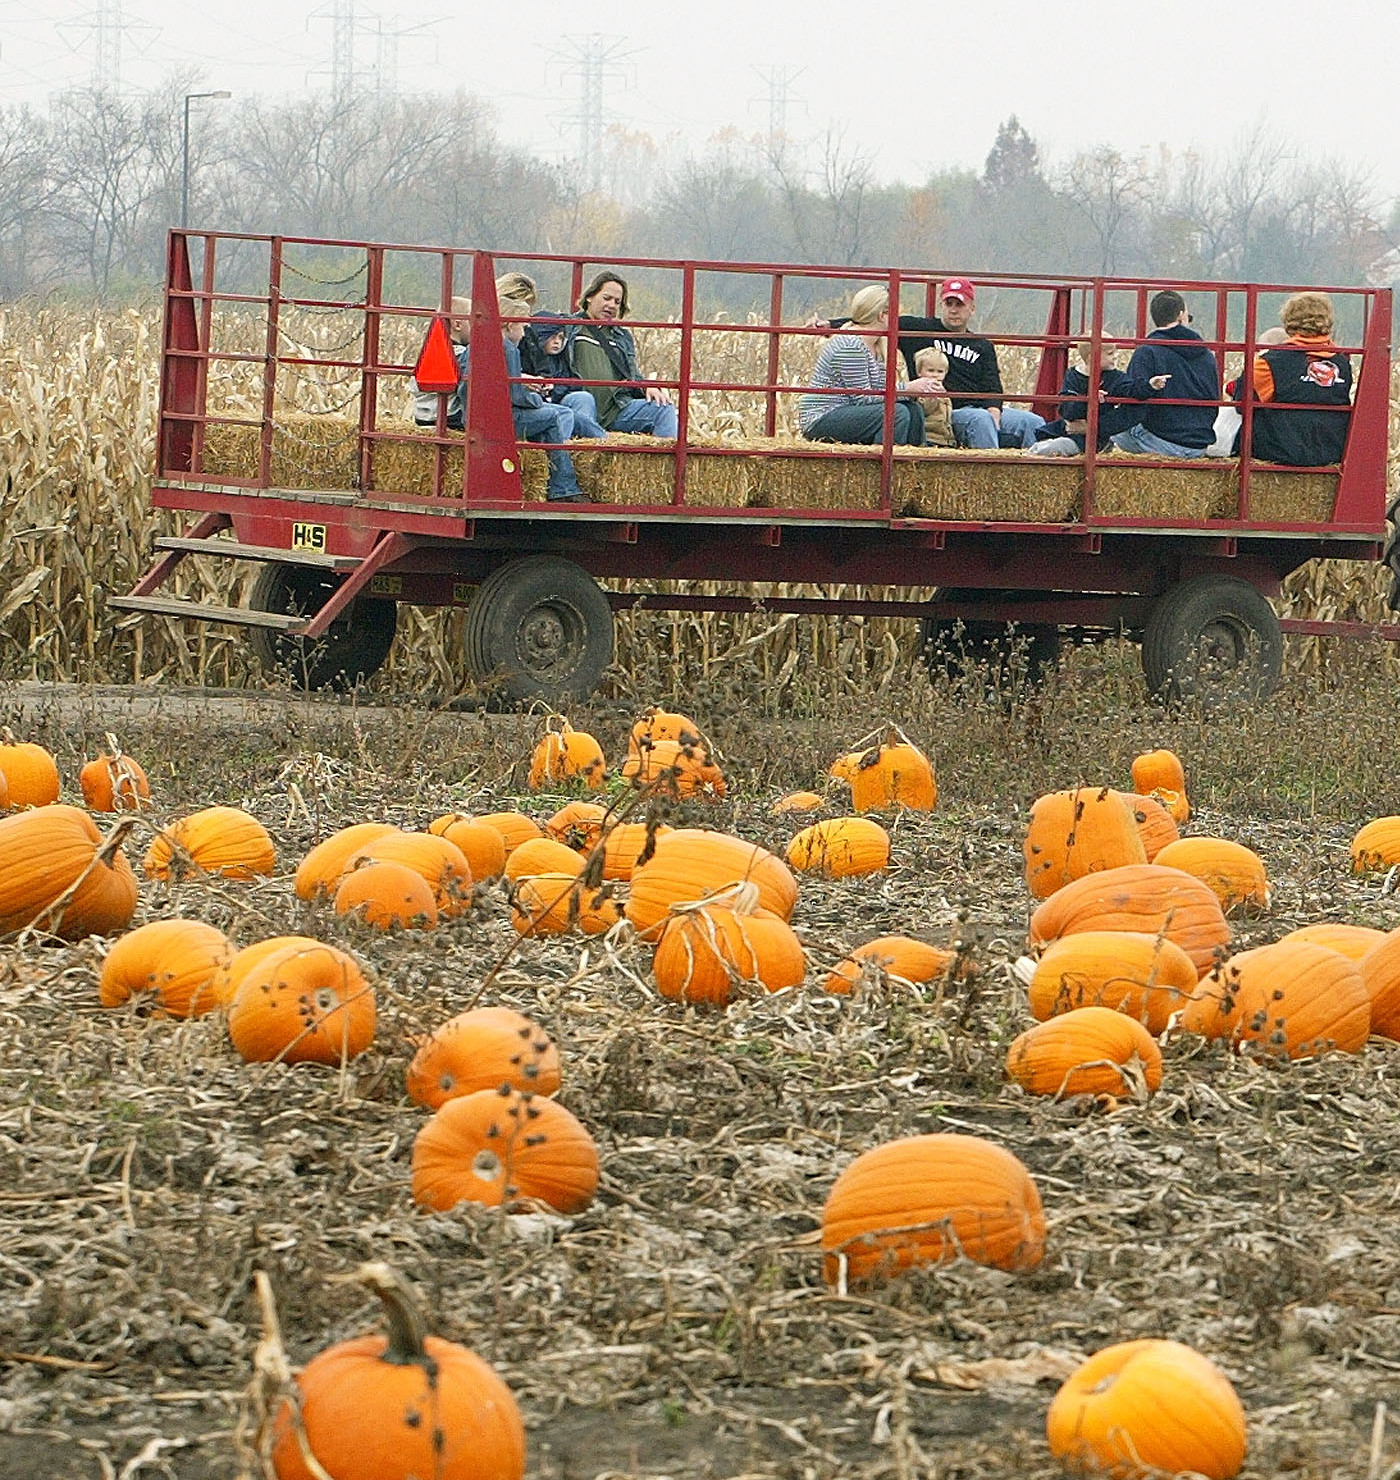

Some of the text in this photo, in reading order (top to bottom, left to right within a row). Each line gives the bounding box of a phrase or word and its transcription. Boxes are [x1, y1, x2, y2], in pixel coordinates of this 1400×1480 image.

[934, 340, 980, 363] OLD NAVY
[294, 524, 324, 548] H&S
